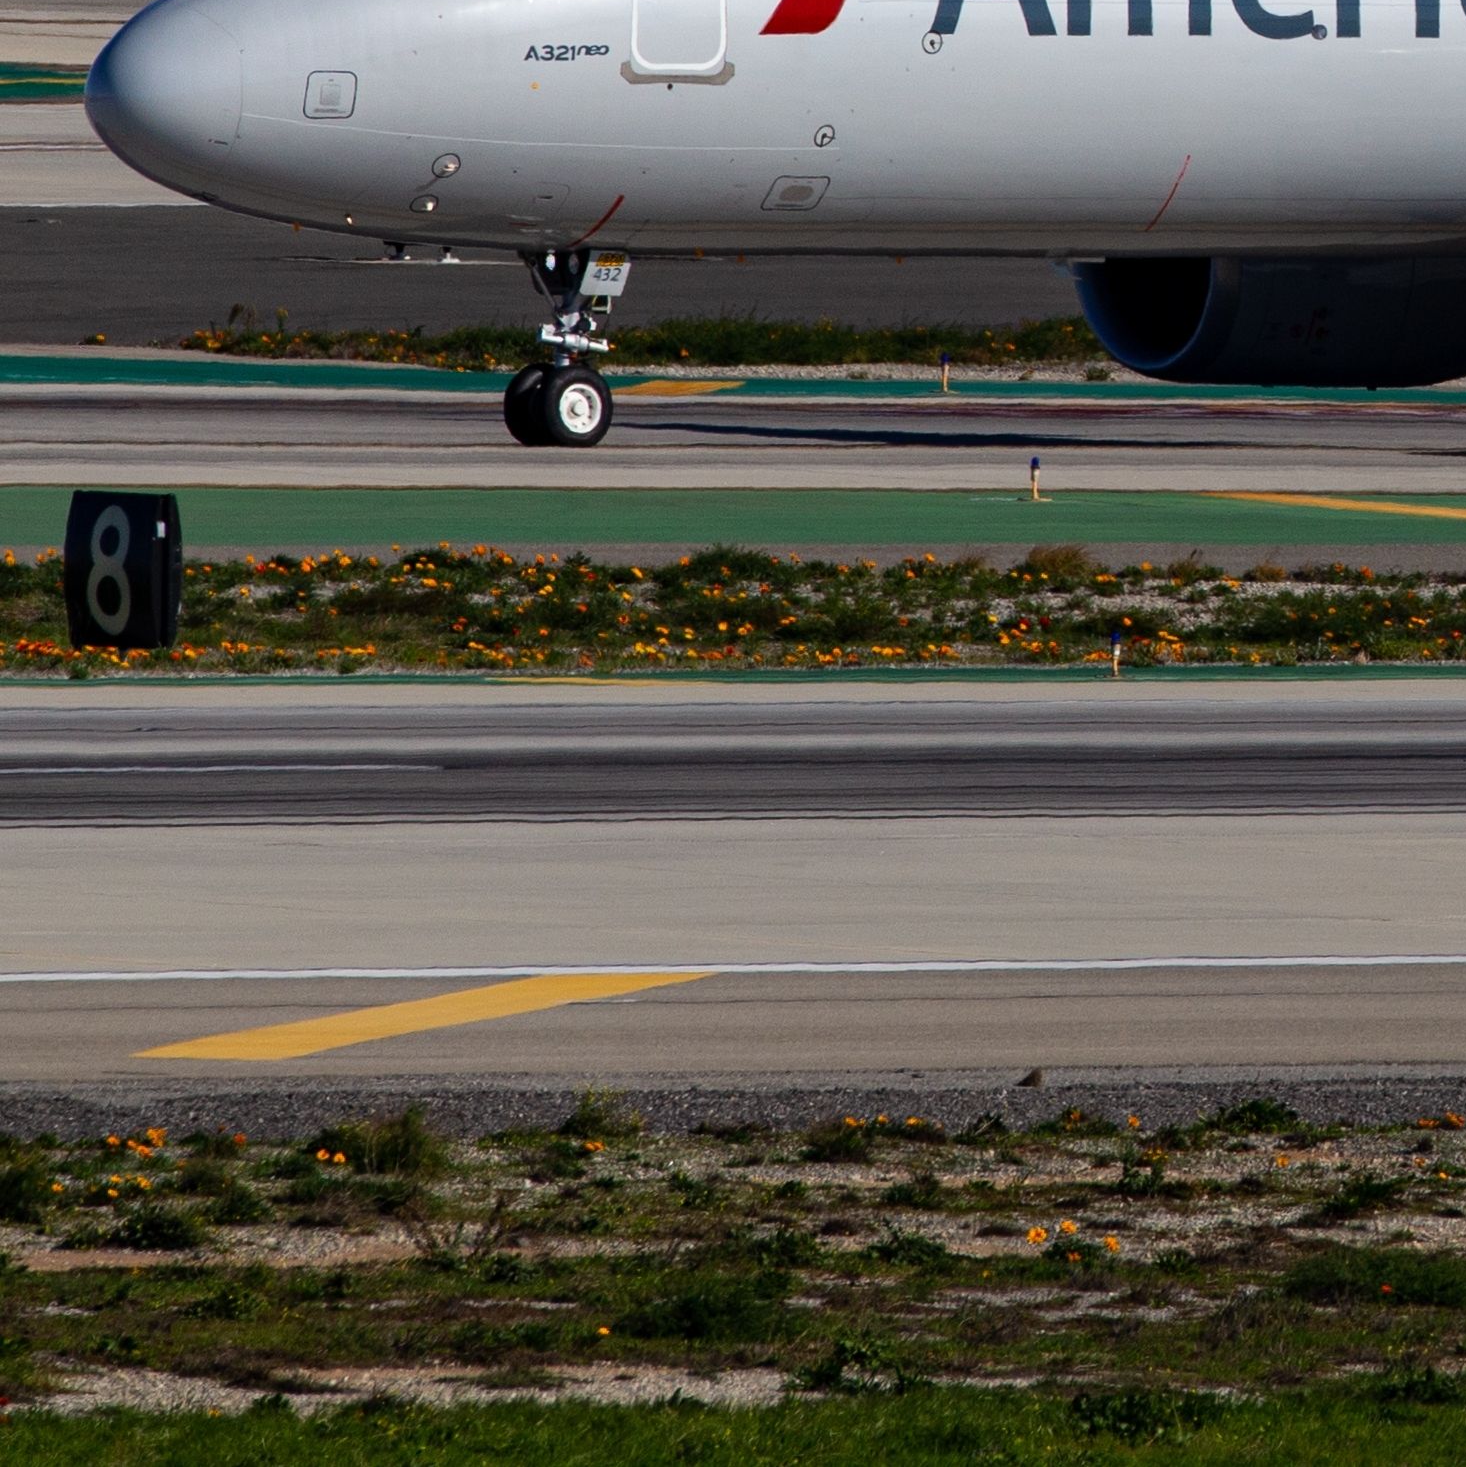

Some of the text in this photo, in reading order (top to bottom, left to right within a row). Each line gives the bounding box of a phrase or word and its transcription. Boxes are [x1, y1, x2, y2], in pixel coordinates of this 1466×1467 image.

[524, 44, 610, 61] A321neo
[592, 267, 622, 282] 432
[86, 504, 132, 636] 8
